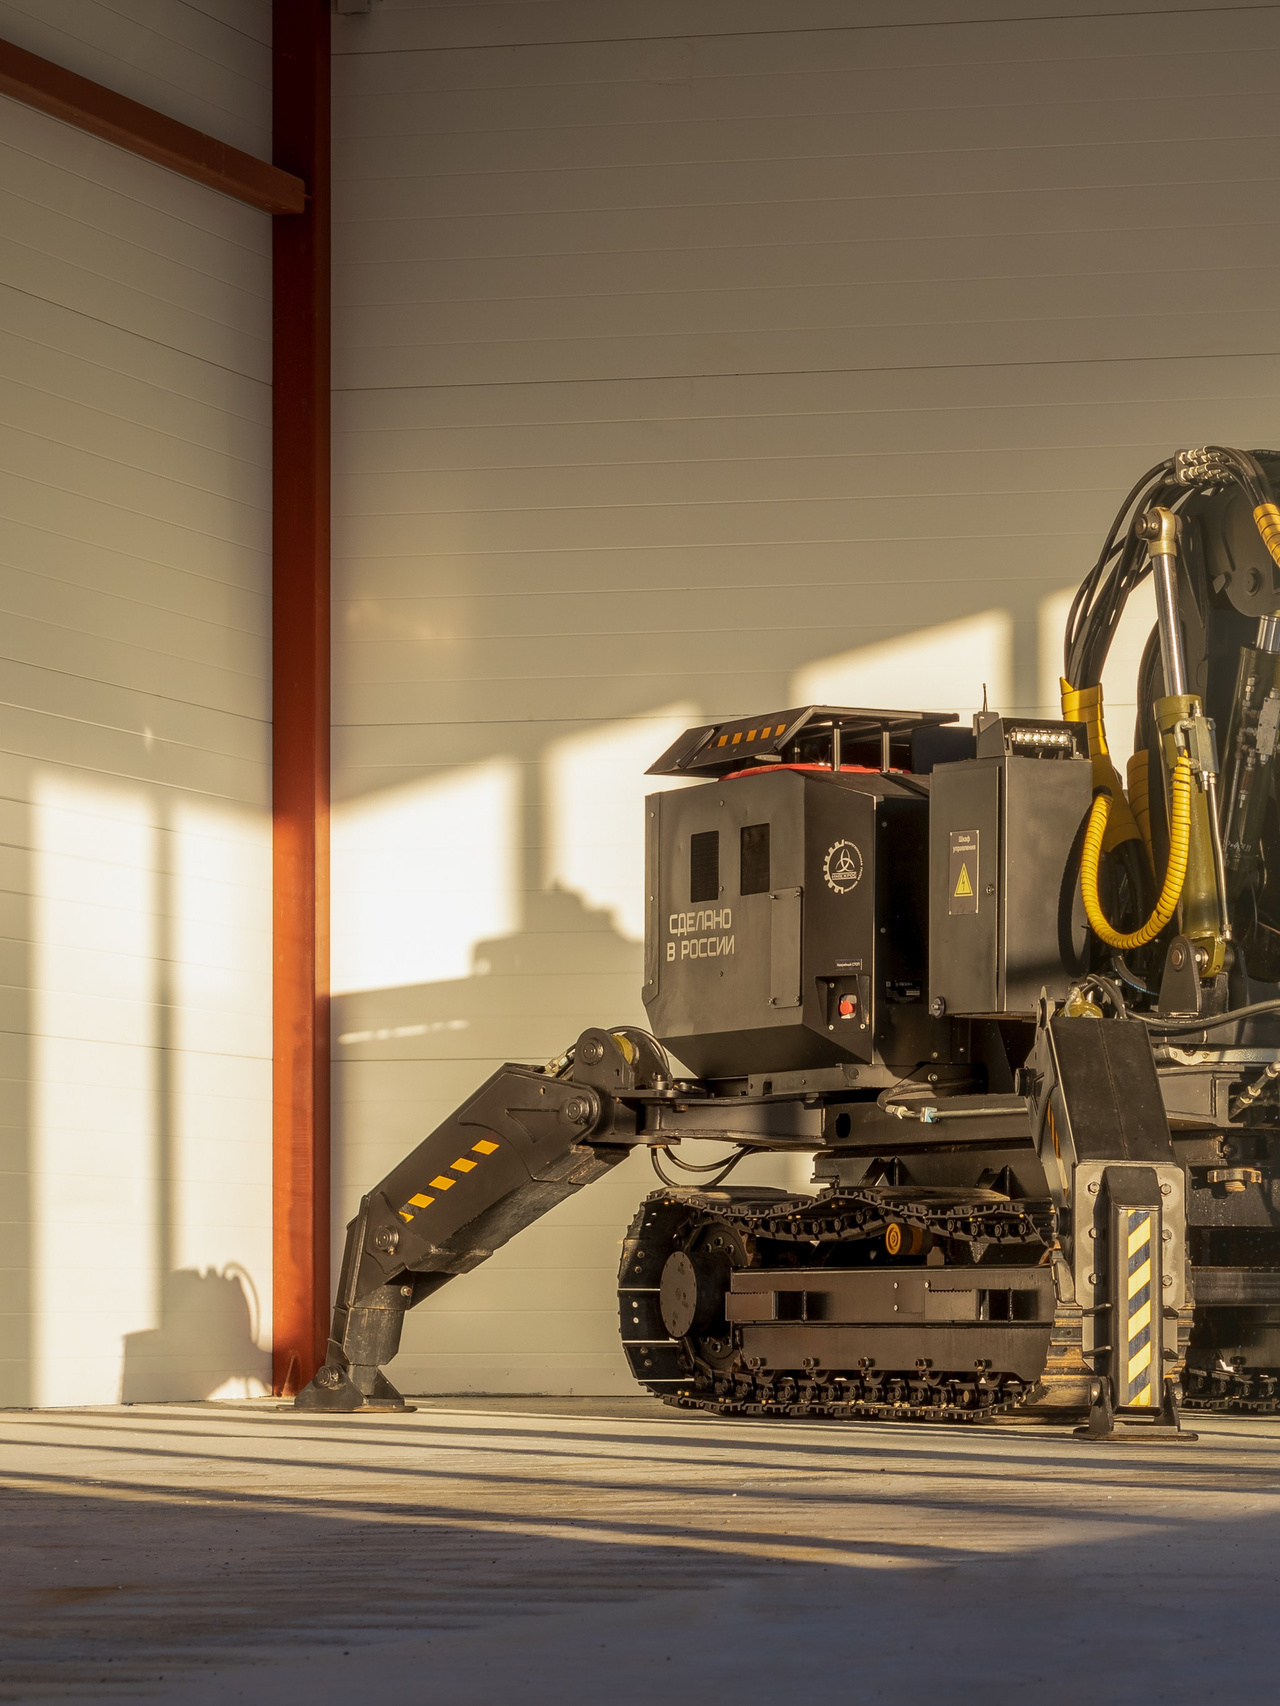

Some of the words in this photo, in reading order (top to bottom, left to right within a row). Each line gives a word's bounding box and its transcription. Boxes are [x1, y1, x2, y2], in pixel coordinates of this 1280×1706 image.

[669, 908, 732, 937] СДЕЛАНО
[666, 941, 676, 962] В
[681, 935, 735, 960] РОССИИ
